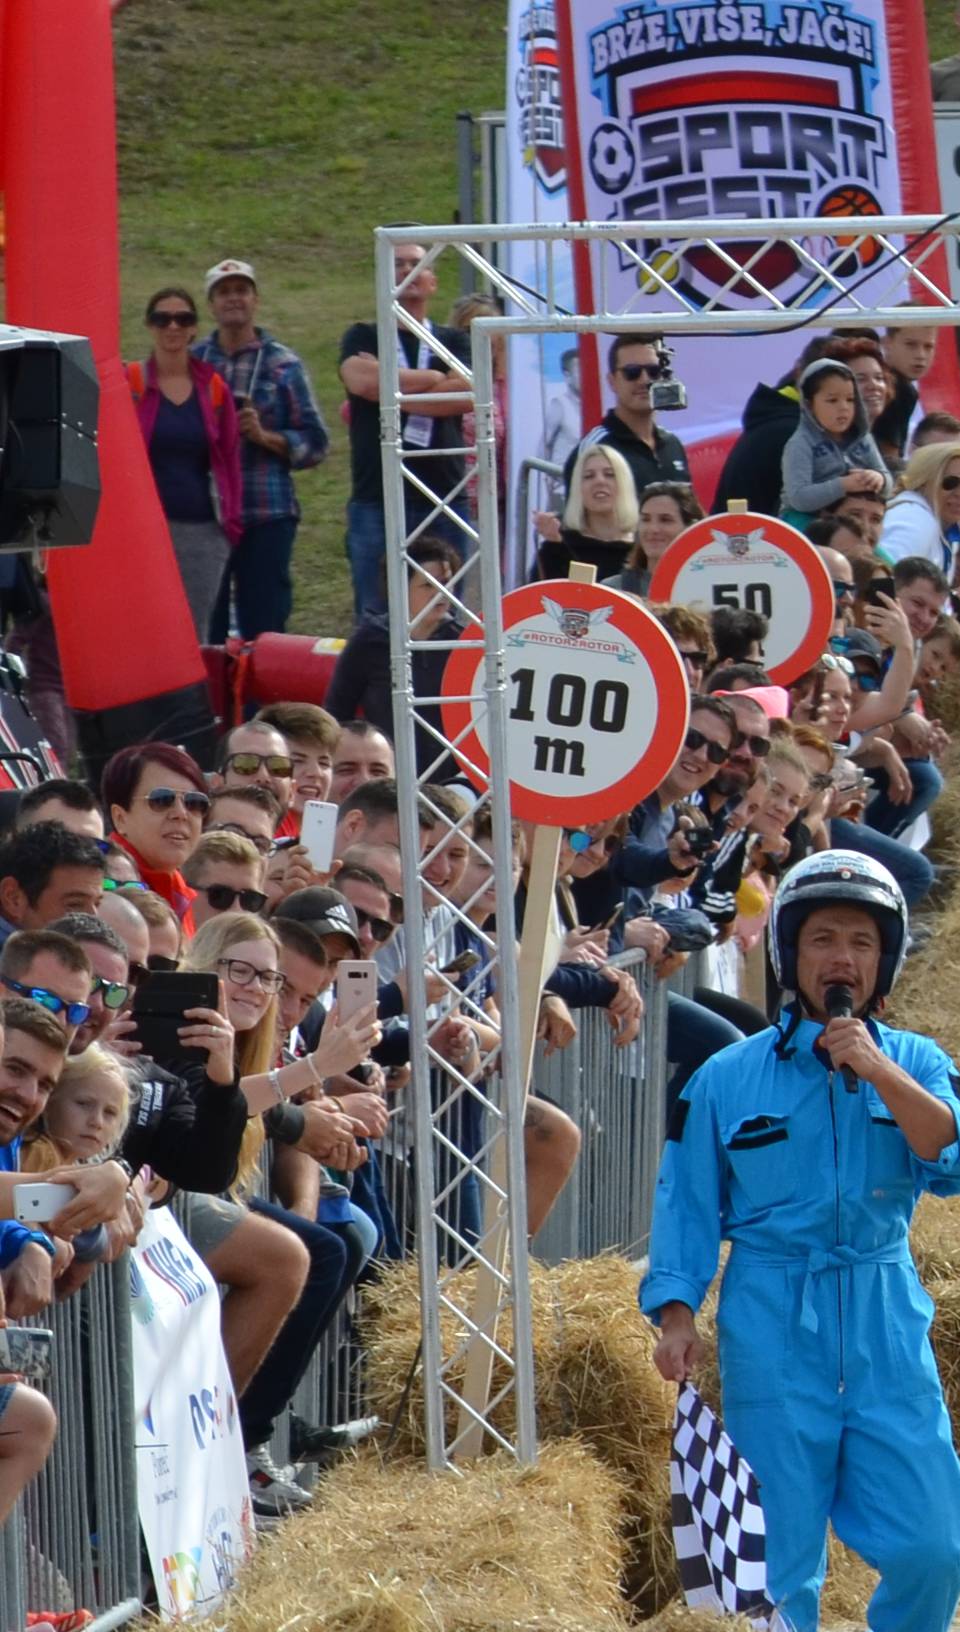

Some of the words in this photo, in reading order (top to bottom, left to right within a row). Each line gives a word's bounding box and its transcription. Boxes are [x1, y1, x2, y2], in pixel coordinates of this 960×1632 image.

[591, 9, 677, 72] BRŽE,
[676, 0, 773, 46] VIŠE,
[779, 5, 873, 60] JAČE!
[638, 111, 877, 183] SPORT
[712, 582, 772, 620] 50
[522, 632, 621, 653] #ROTOR2ROTOR
[509, 667, 630, 734] 100
[533, 735, 586, 777] m
